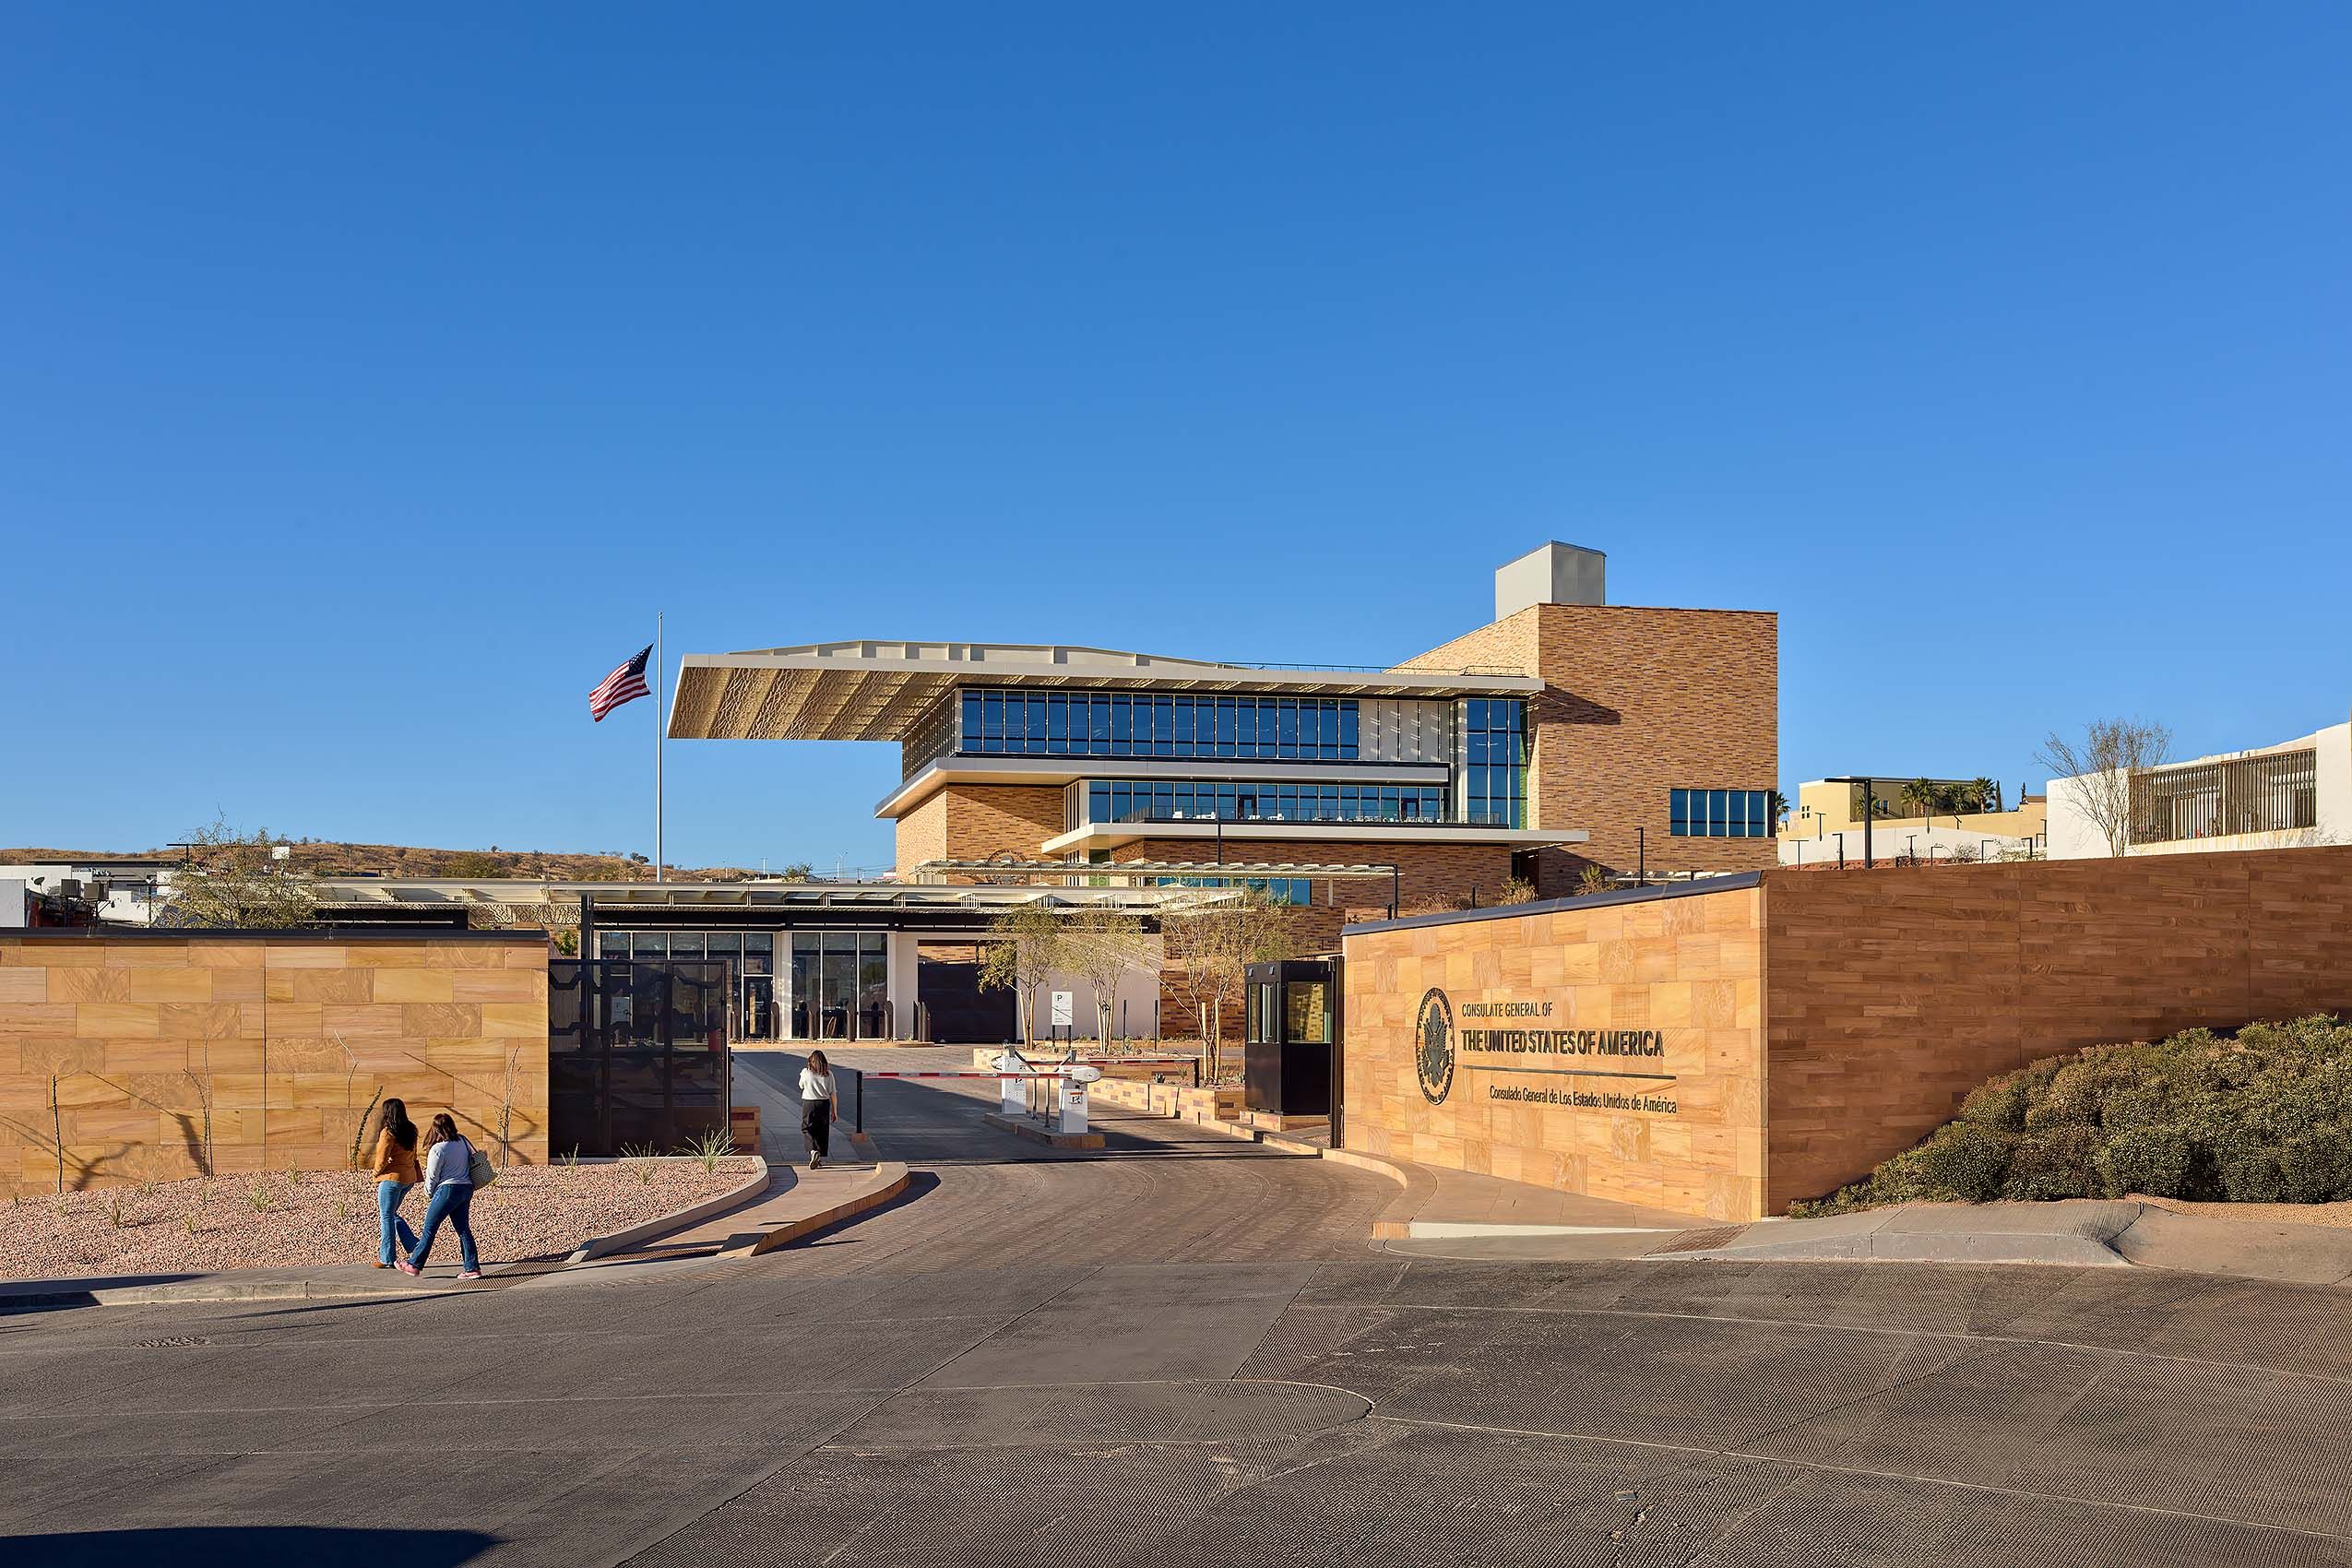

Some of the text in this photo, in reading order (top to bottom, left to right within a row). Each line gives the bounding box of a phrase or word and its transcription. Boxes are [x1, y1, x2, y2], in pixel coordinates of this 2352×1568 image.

[1461, 1002, 1553, 1017] CONSULATE GENERAL OF
[1461, 1029, 1665, 1057] THE UNITED STATES OF AMERICA
[1490, 1085, 1677, 1113] Consulado General de Los Estados Unidos de América
